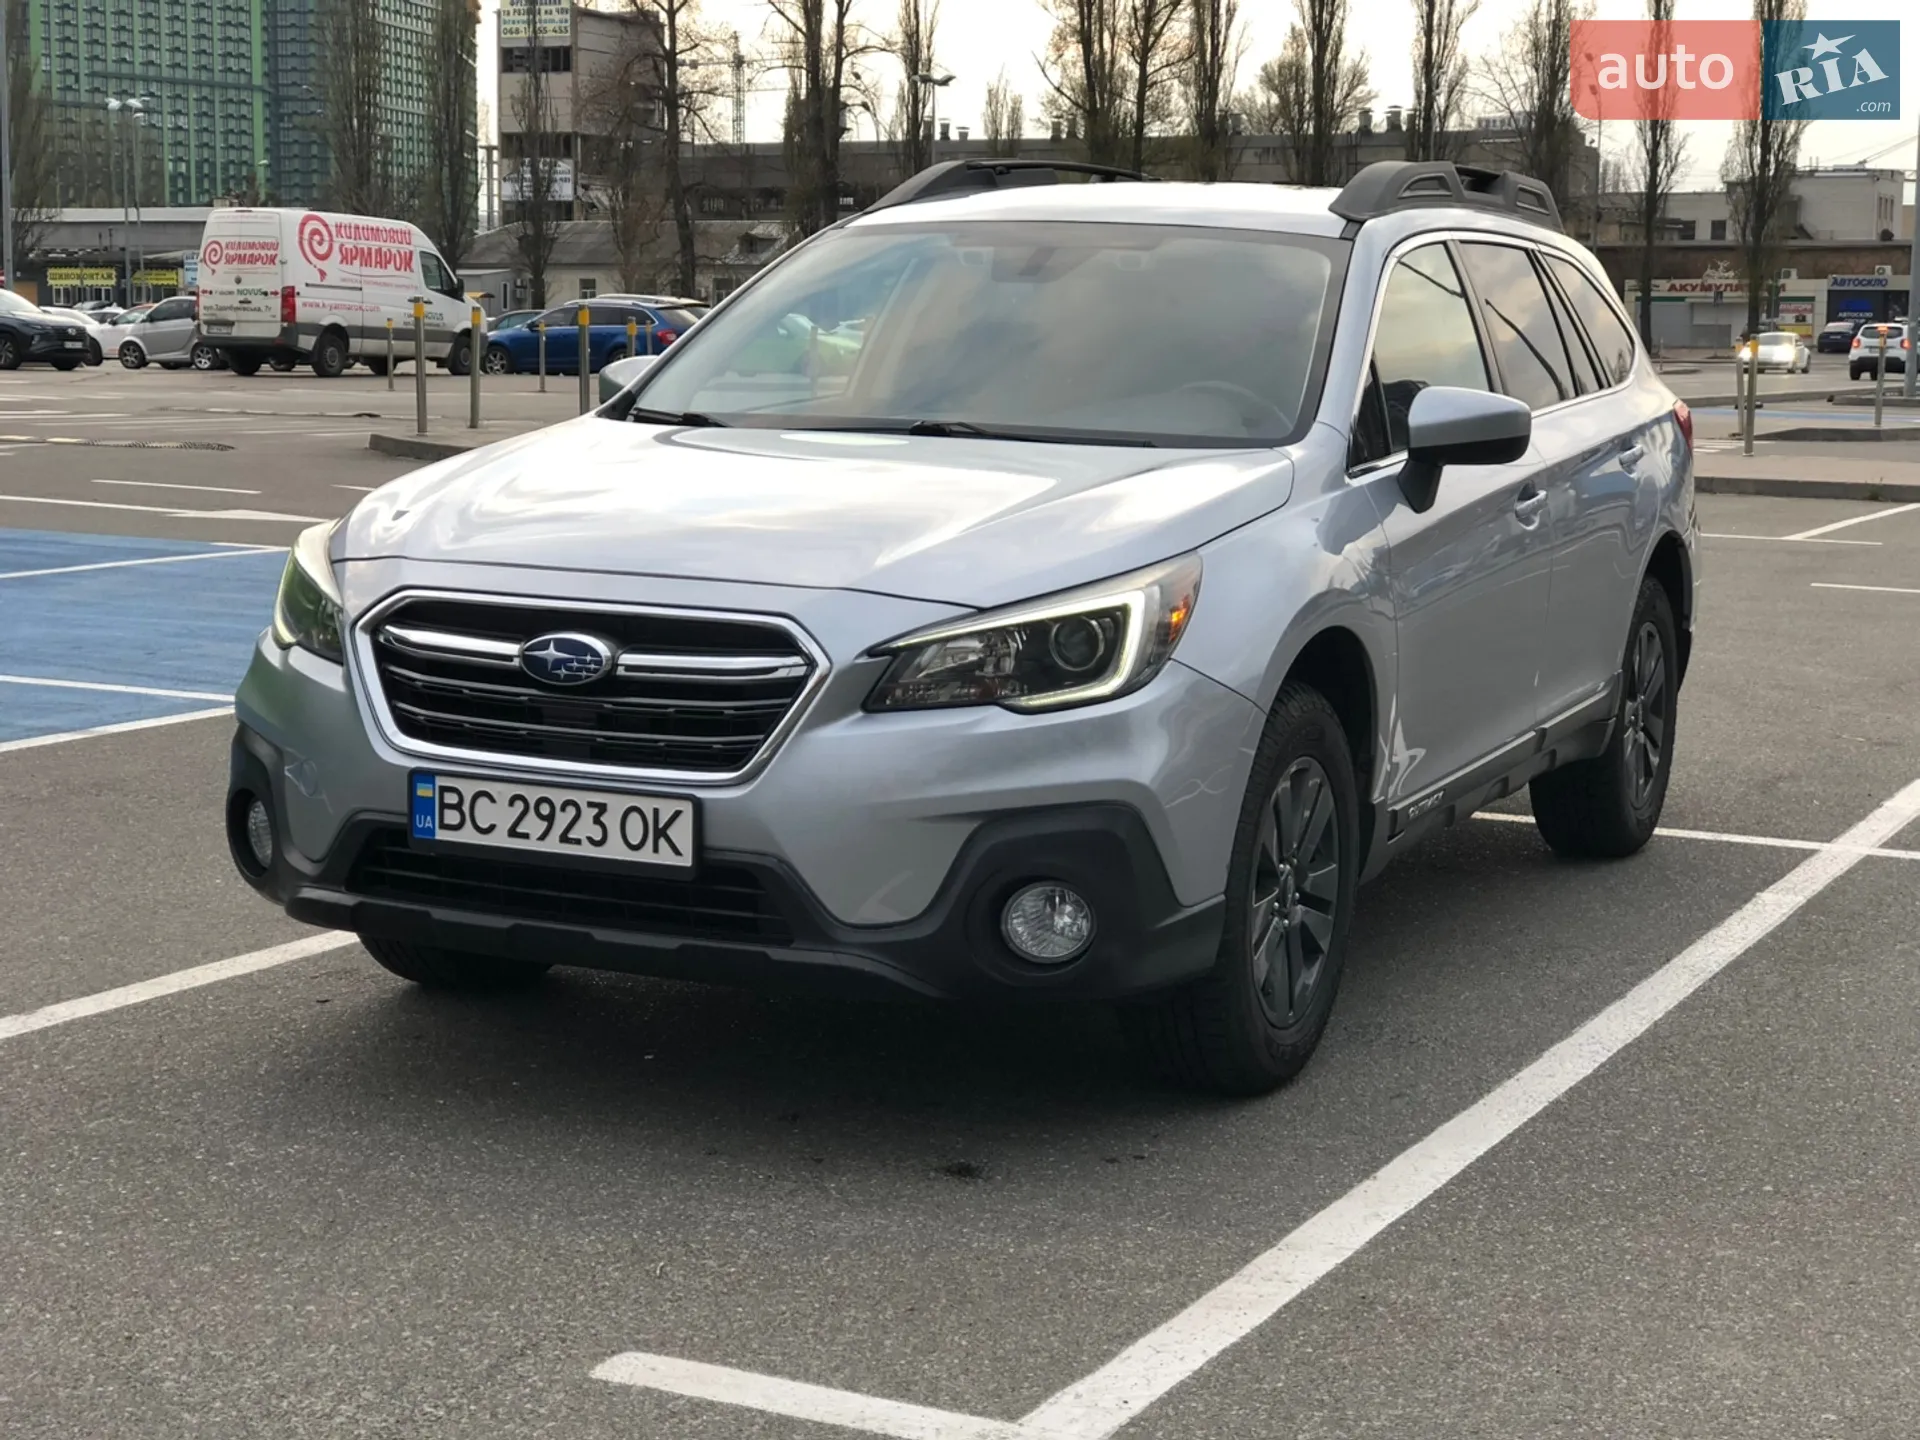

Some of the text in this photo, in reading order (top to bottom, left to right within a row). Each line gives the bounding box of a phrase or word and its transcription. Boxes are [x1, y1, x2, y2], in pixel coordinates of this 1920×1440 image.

[335, 222, 412, 245] КИЛИМОВИЙ
[223, 252, 278, 266] ЯРМАРОК
[339, 243, 414, 273] ЯРМАРОК
[1831, 276, 1889, 288] АВТОСКЛО
[236, 287, 263, 297] NOVUS
[416, 814, 433, 829] UA
[438, 785, 683, 857] BC 2923 OK
